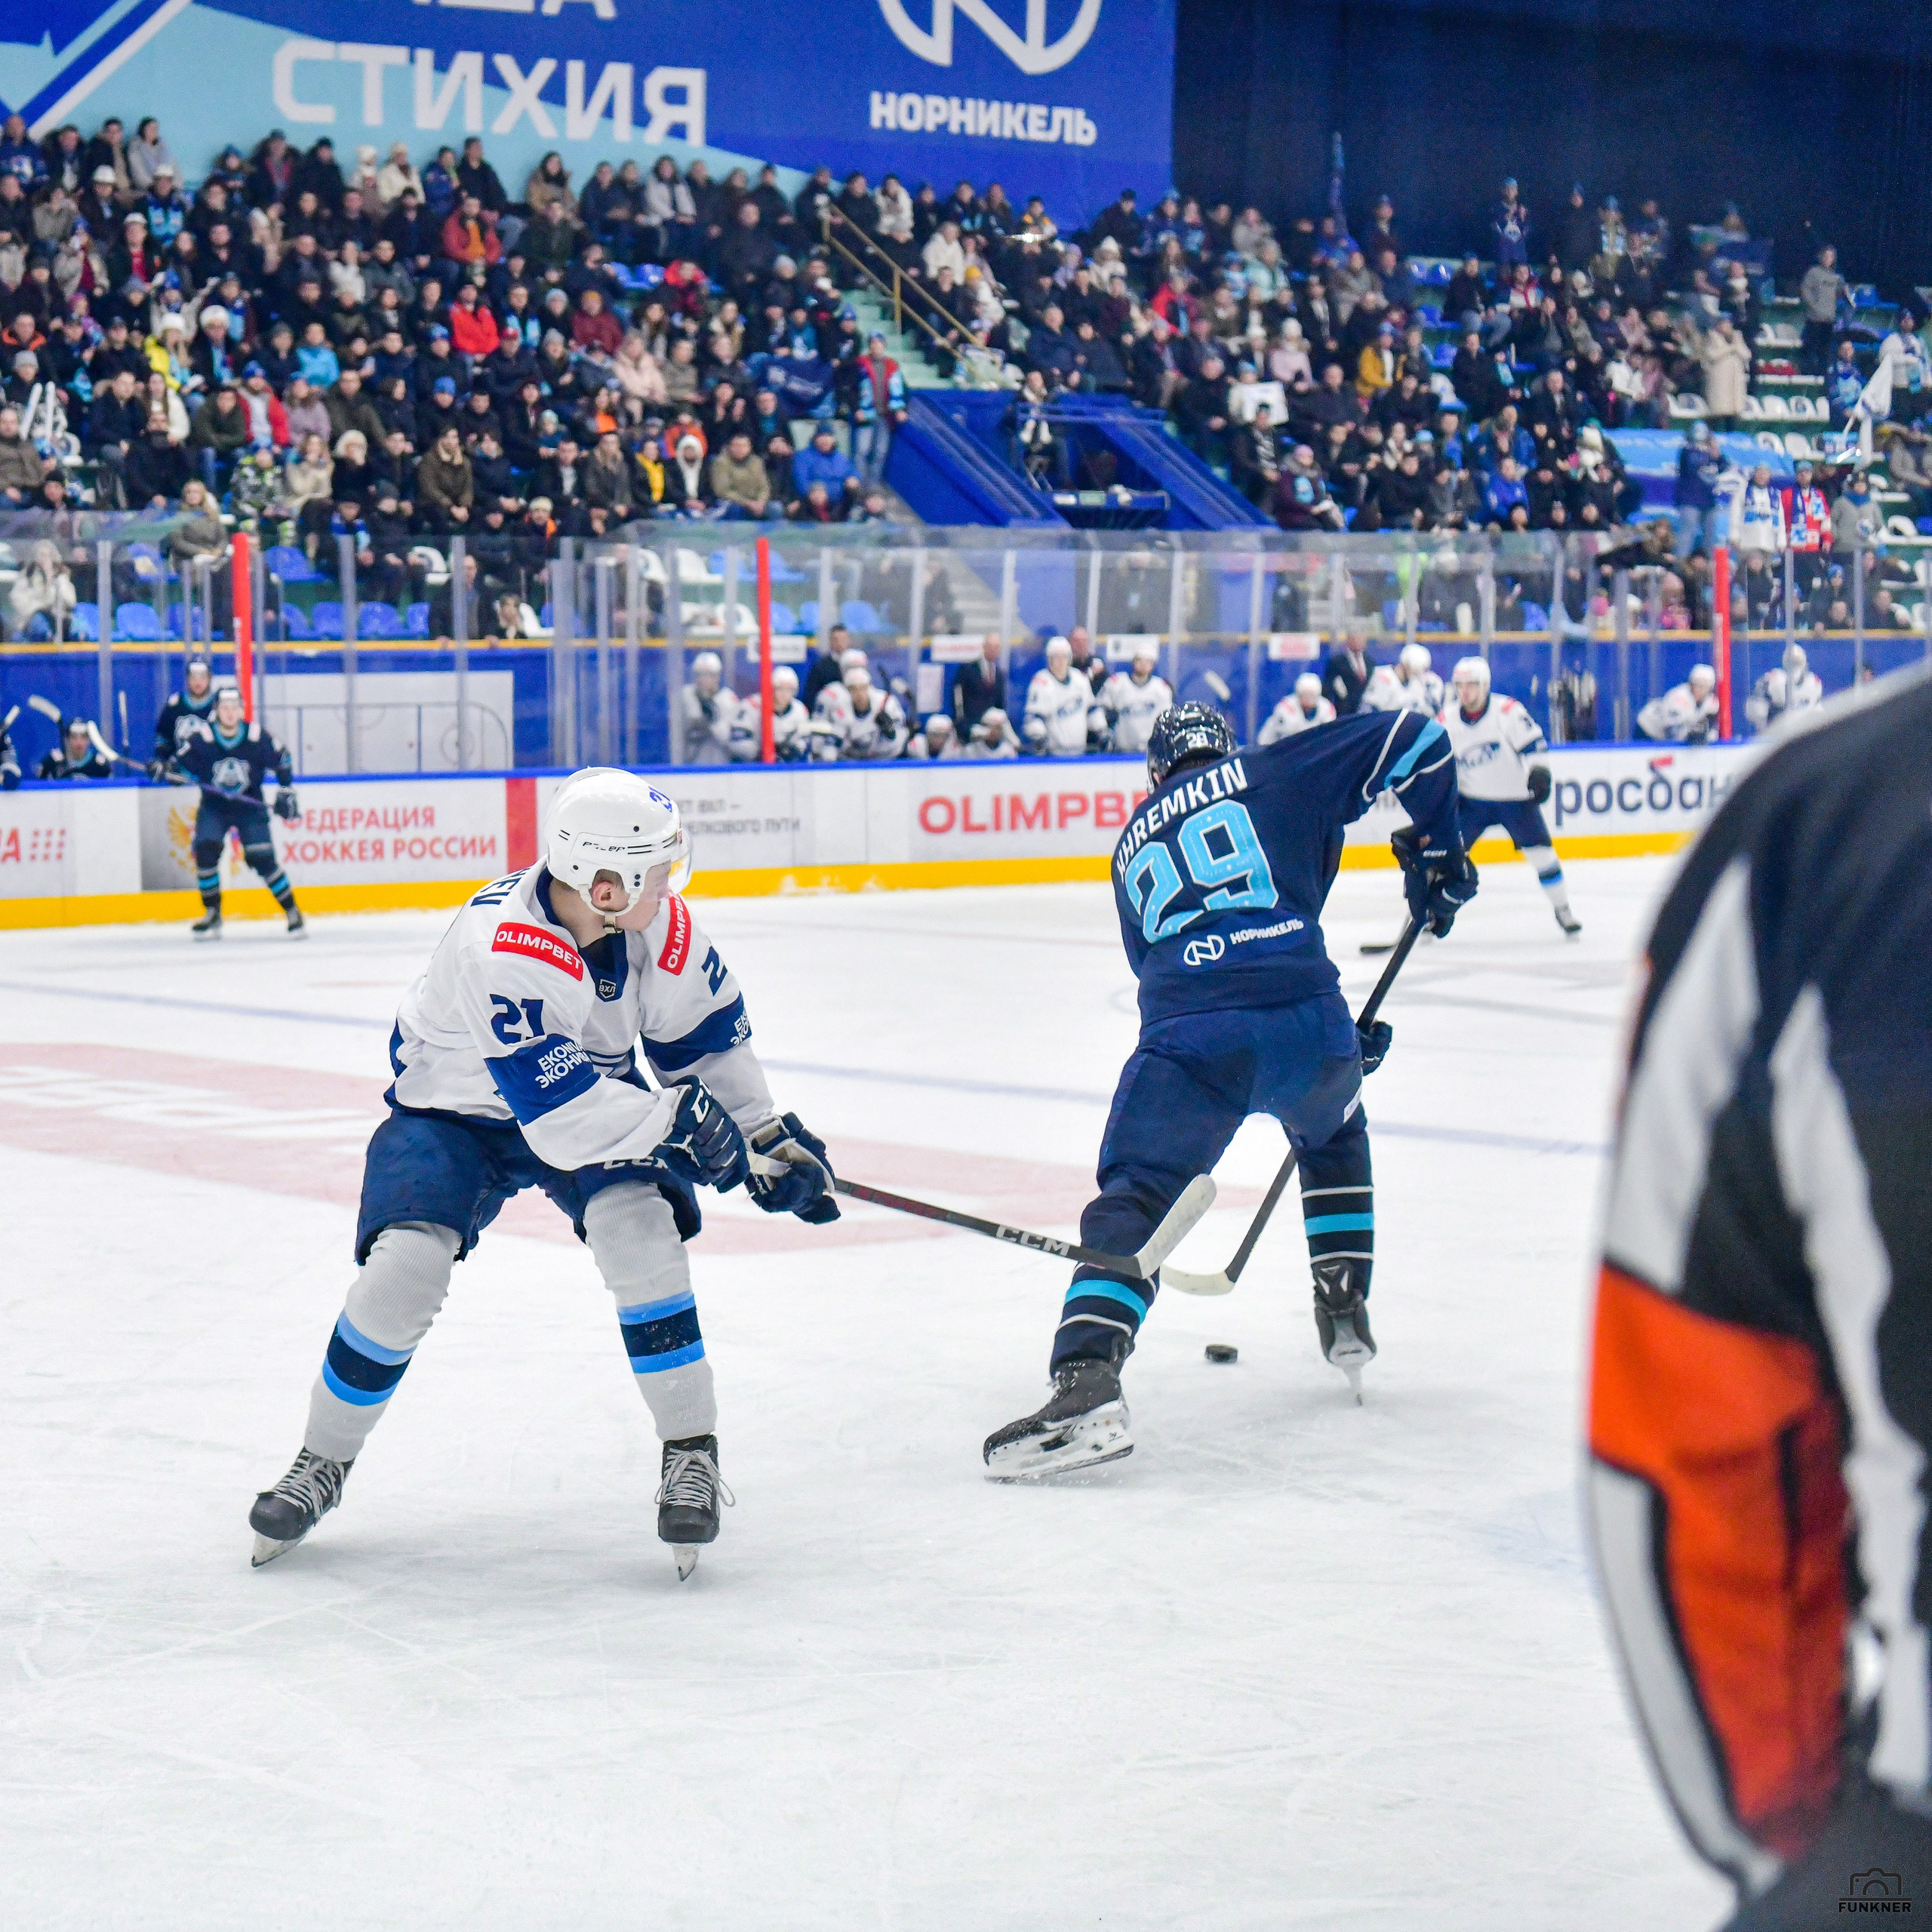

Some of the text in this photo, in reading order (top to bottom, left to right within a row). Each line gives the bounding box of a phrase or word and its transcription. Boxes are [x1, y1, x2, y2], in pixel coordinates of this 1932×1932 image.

[272, 39, 706, 147] СТИХИЯ
[870, 91, 1097, 146] НОРНИКЕЛЬ
[1555, 755, 1730, 826] росбан
[282, 834, 497, 864] ХОККЕЯ РОССИИ
[1124, 799, 1280, 943] 29
[495, 930, 582, 970] OLIMPBET
[598, 984, 617, 993] ВХЛ
[490, 994, 547, 1045] 21
[995, 1224, 1072, 1257] CCM
